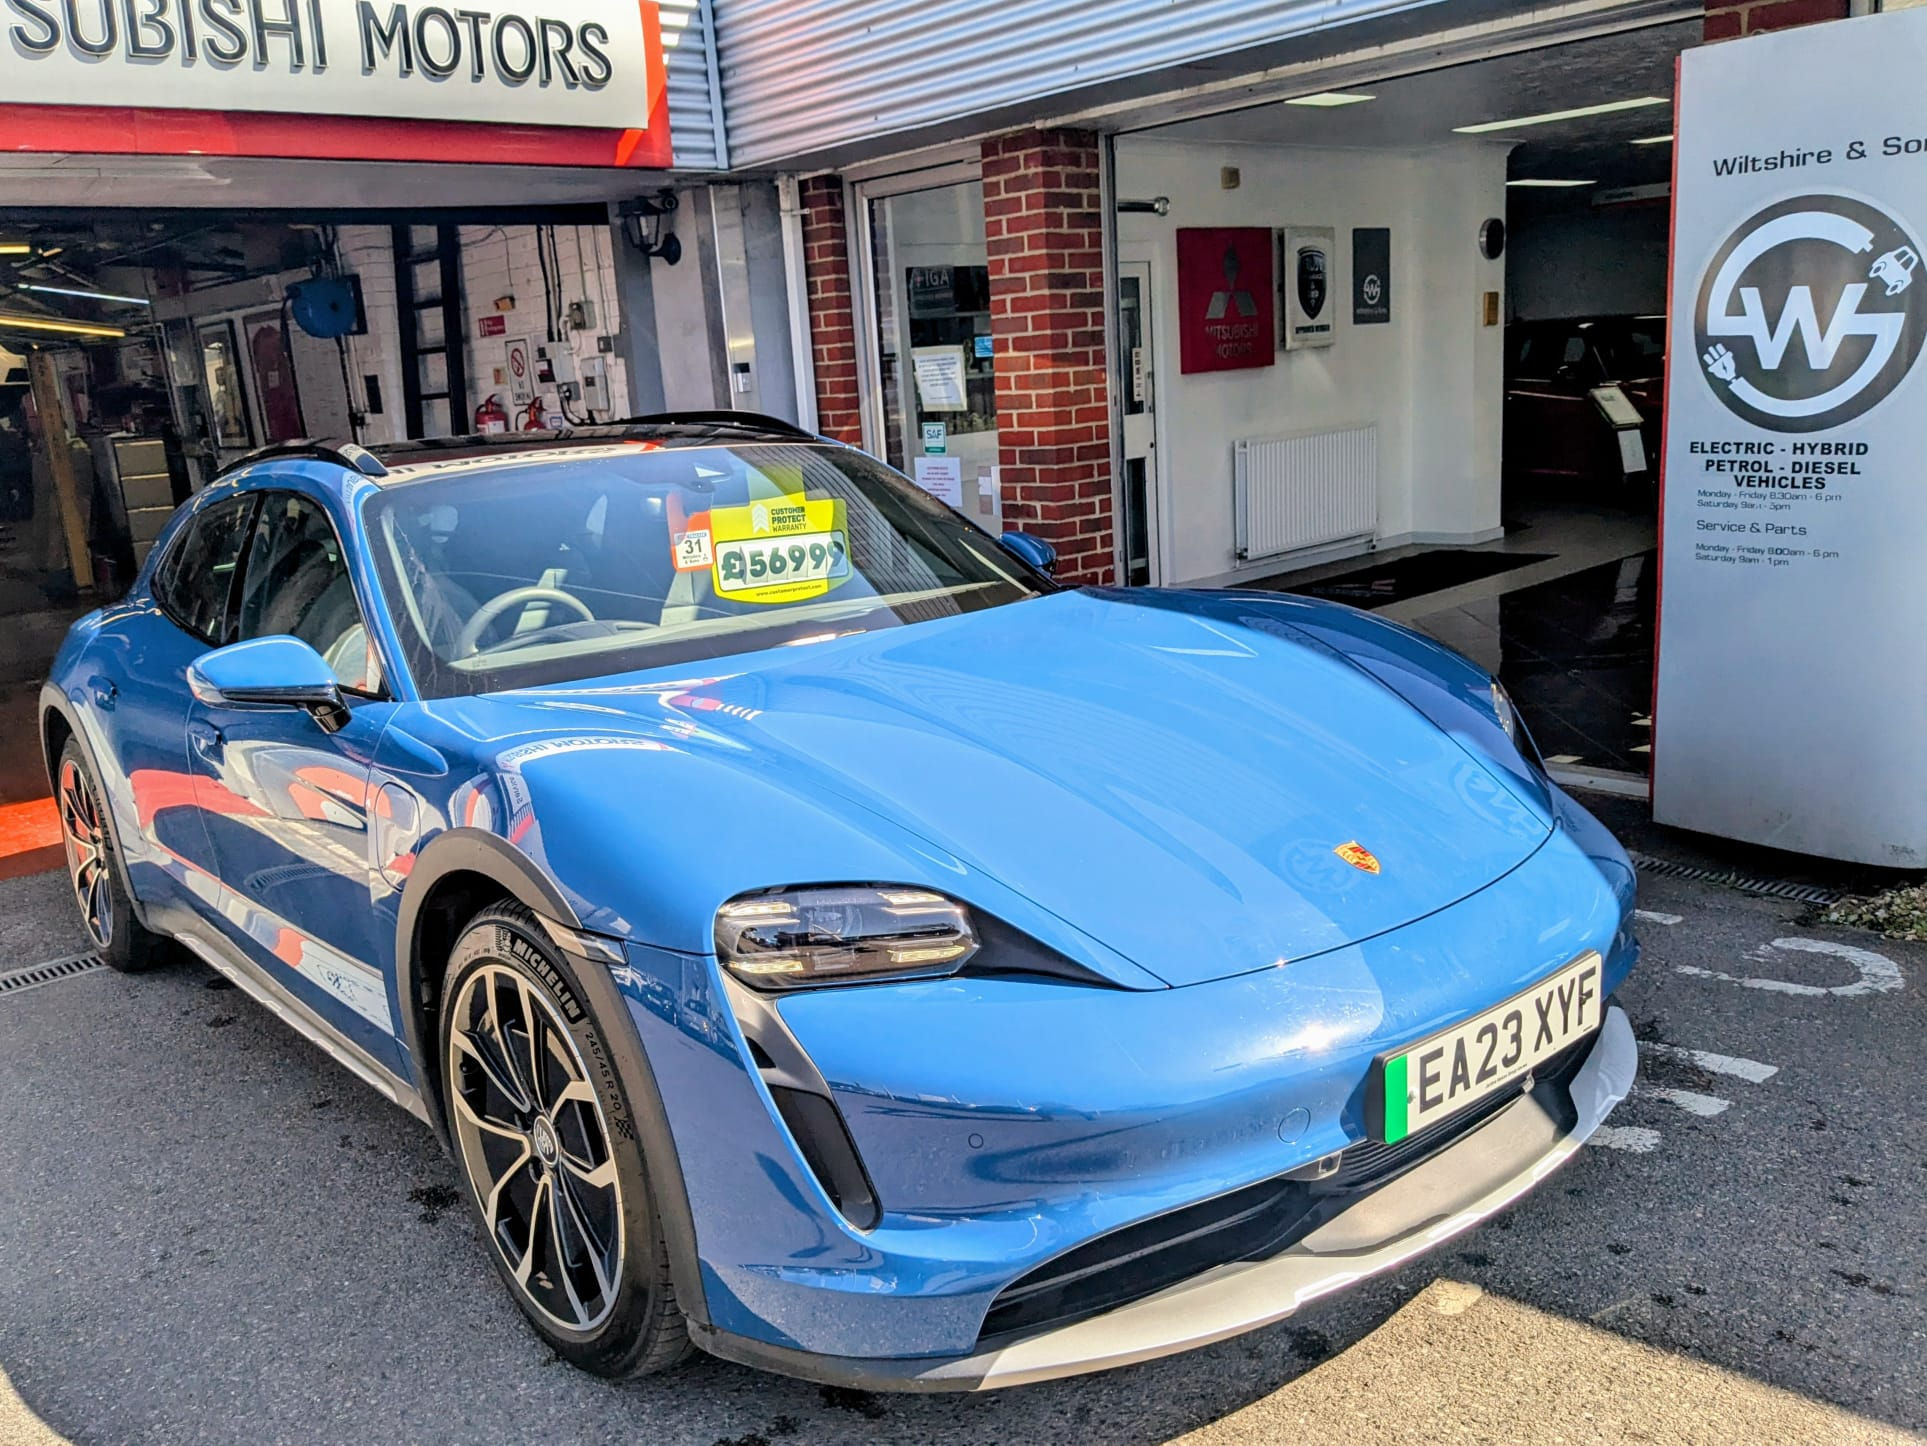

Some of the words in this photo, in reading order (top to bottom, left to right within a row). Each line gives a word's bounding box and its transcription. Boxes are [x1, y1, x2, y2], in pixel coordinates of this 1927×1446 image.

[357, 0, 613, 88] MOTORS
[1713, 148, 1833, 177] Wiltshire
[1846, 140, 1867, 161] &
[1882, 136, 1927, 156] So
[1690, 441, 1775, 455] ELECTRIC
[1792, 443, 1869, 456] HYBRID
[1705, 459, 1774, 473] PETROL
[1791, 461, 1862, 475] DIESEL
[1734, 475, 1827, 490] VEHICLES
[1697, 489, 1732, 499] Monday
[1738, 491, 1767, 501] Friday
[1824, 494, 1842, 503] pm
[770, 506, 805, 516] CUSTOMER
[1697, 499, 1738, 510] Saturday
[771, 514, 806, 524] PROTECT
[772, 523, 807, 533] WARRANTY
[1696, 520, 1746, 533] Service
[1750, 522, 1761, 533] &
[1765, 523, 1808, 536] Parts
[684, 538, 702, 554] 31
[1695, 543, 1730, 554] Monday
[1737, 546, 1765, 556] Friday
[1823, 551, 1840, 560] pm
[721, 541, 845, 582] £56999
[1695, 553, 1736, 564] Saturday
[1739, 554, 1761, 564] 9am
[512, 938, 581, 1018] MICHELIN
[1419, 1009, 1523, 1114] EA23
[1533, 966, 1597, 1054] XYF
[585, 1031, 610, 1078] 245/45
[610, 1093, 622, 1110] 20
